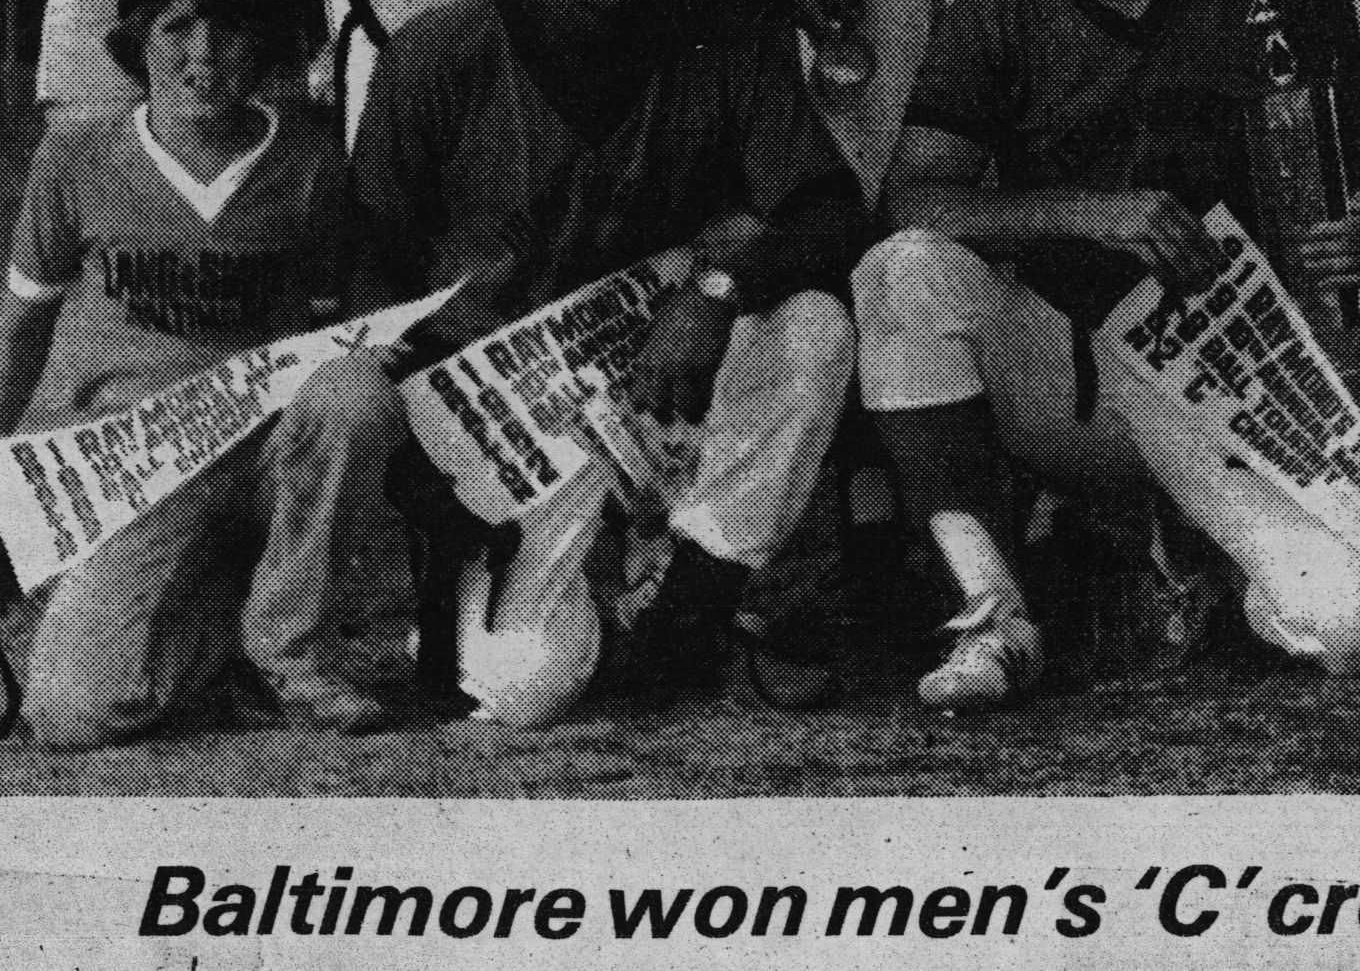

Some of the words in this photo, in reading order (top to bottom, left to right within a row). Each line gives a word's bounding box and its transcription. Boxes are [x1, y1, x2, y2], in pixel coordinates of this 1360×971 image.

[452, 355, 563, 487] 1982
[1196, 331, 1254, 401] BALL
[1241, 281, 1358, 442] RAYMOND'S
